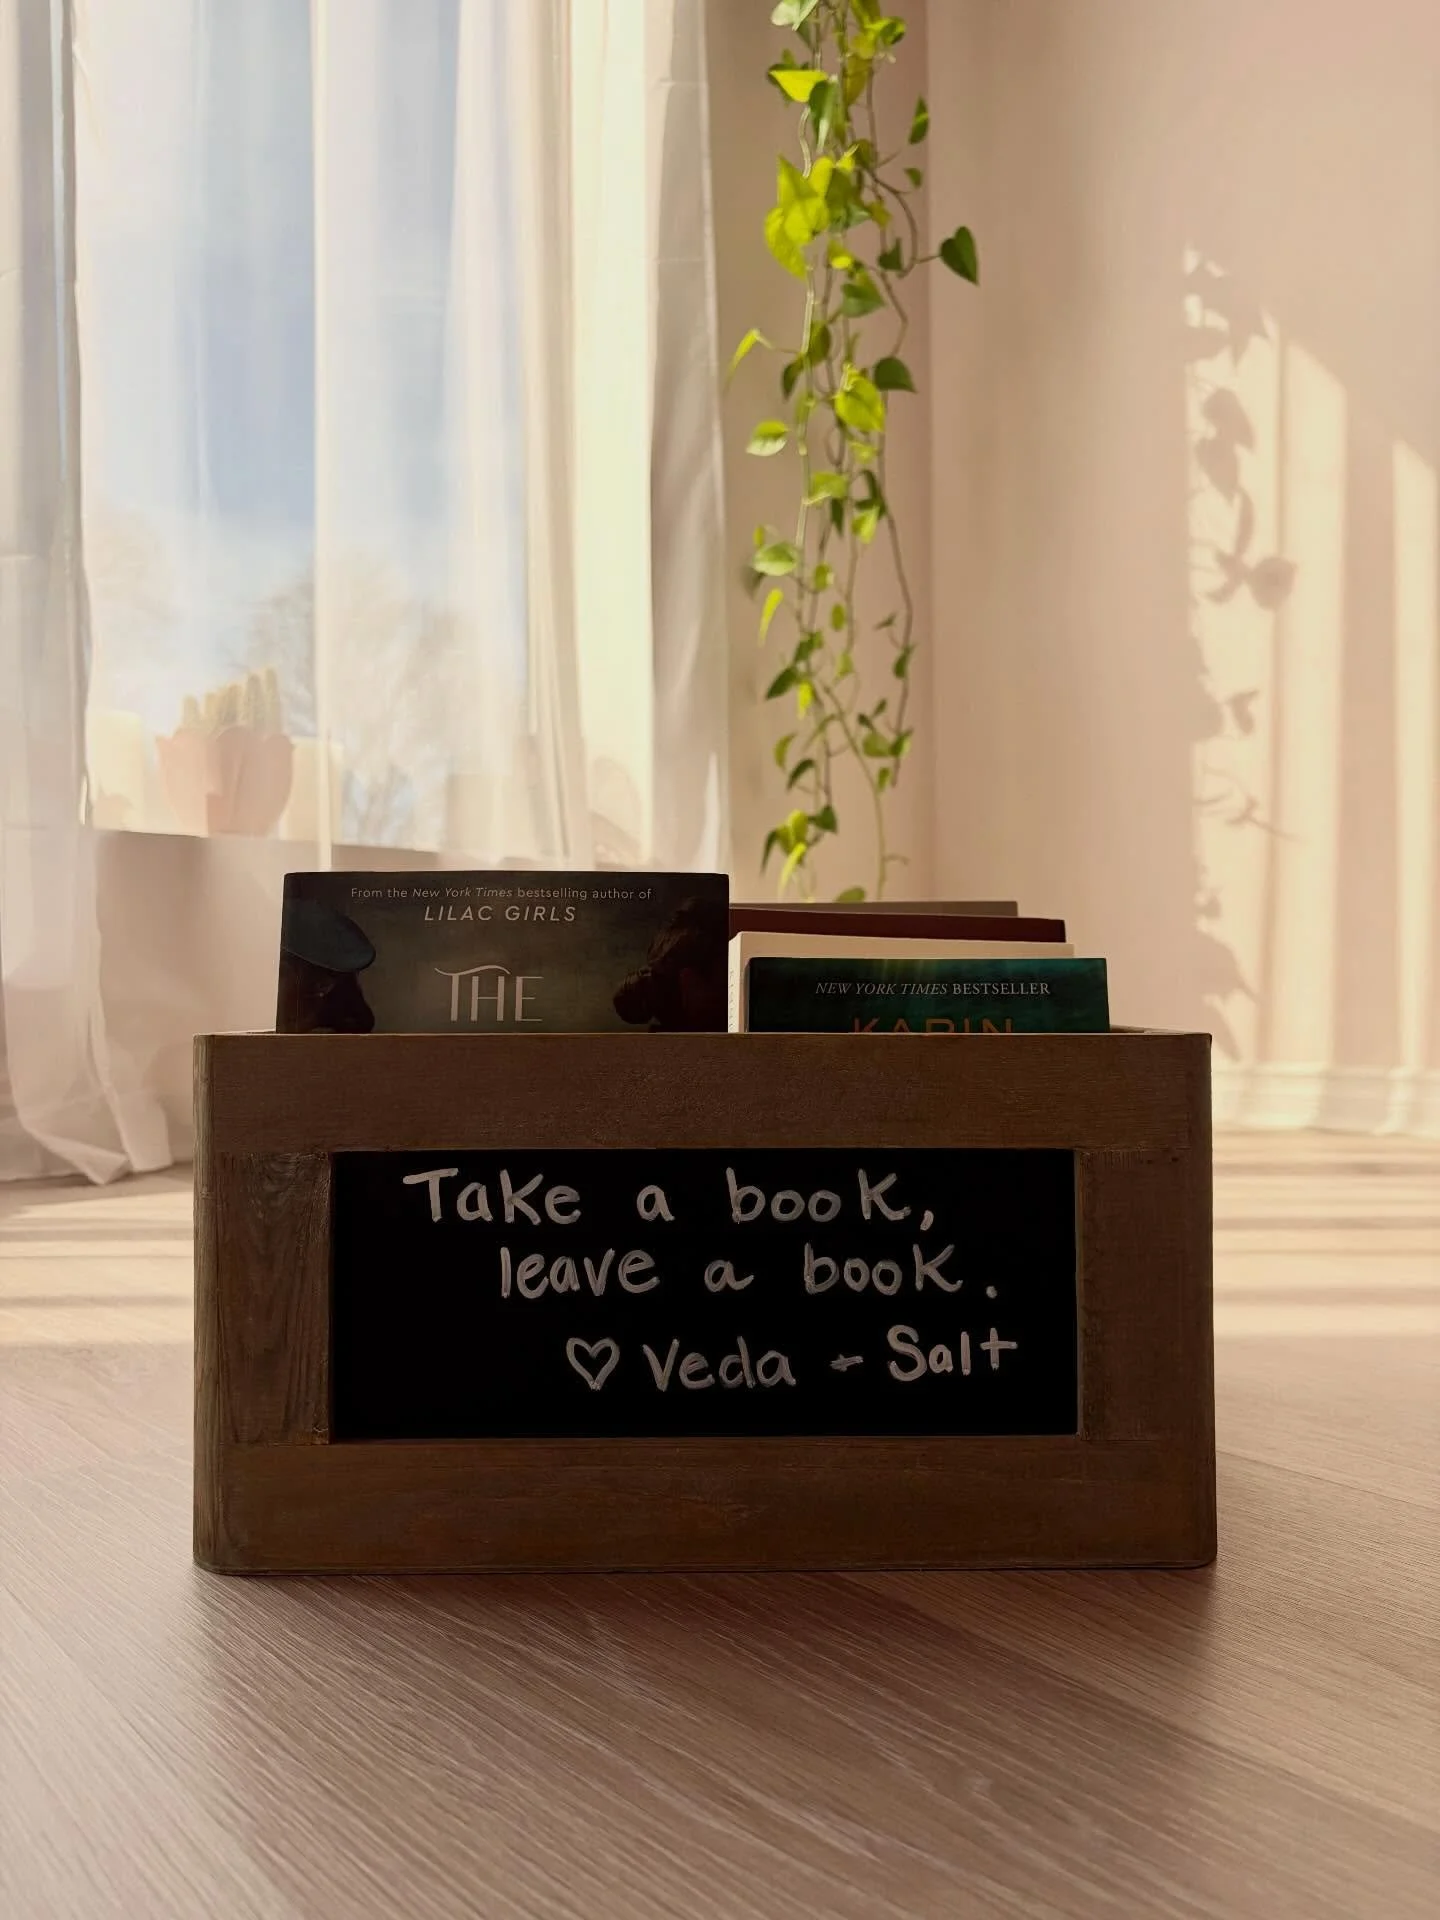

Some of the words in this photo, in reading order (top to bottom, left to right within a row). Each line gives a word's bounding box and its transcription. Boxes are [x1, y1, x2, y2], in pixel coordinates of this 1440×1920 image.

[351, 886, 382, 898] From
[386, 886, 408, 898] the
[412, 887, 440, 898] New
[445, 887, 472, 898] York
[475, 887, 513, 899] Times
[517, 886, 588, 901] bestselling
[592, 887, 635, 900] author
[638, 887, 653, 900] of
[424, 905, 493, 921] LILAC
[504, 905, 576, 922] GIRLS
[434, 964, 544, 1022] THE
[815, 982, 852, 995] NEW
[855, 982, 897, 995] YORK
[900, 982, 948, 995] TIMES
[952, 982, 1051, 995] BESTSELLER
[636, 1184, 675, 1222] a
[499, 1246, 661, 1300] leave
[703, 1259, 755, 1293] a
[642, 1335, 797, 1393] Veda
[886, 1324, 1018, 1382] Salt
